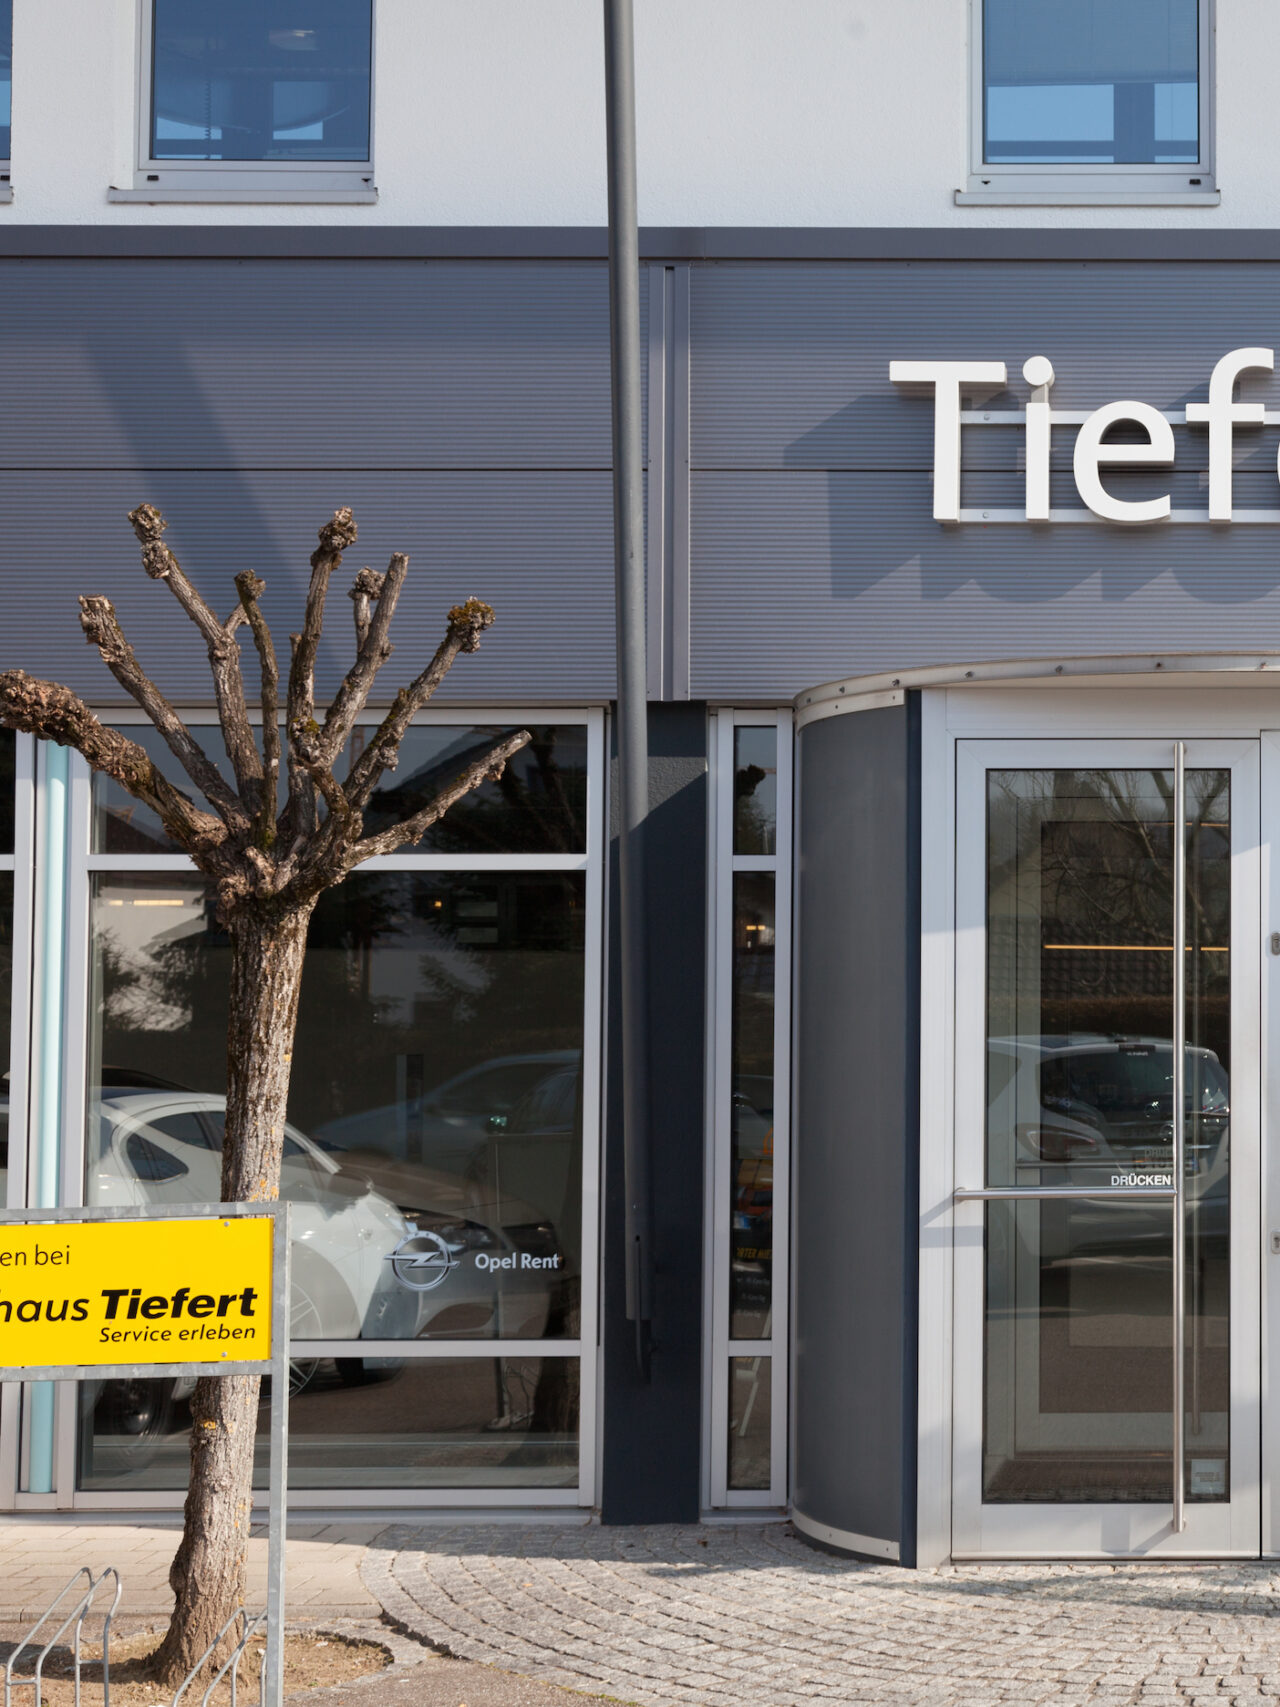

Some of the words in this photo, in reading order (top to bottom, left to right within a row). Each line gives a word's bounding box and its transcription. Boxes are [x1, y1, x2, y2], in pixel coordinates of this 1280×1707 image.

[1111, 1173, 1171, 1186] DRÜCKEN
[35, 1243, 70, 1266] bei
[475, 1252, 516, 1272] Opel
[521, 1252, 559, 1269] Rent
[100, 1287, 258, 1320] Tiefert
[99, 1326, 172, 1342] Service
[178, 1324, 256, 1341] erleben
